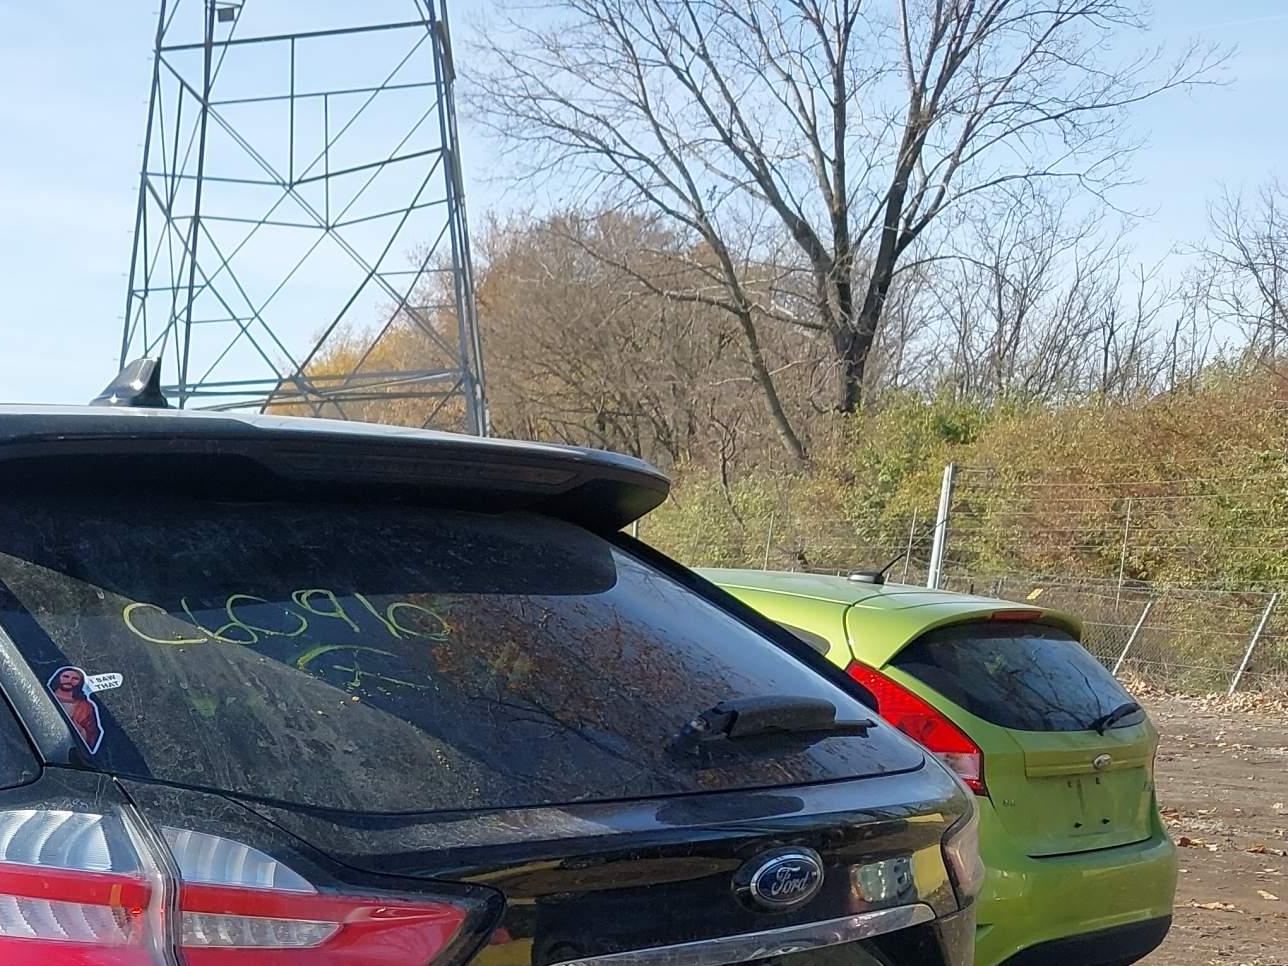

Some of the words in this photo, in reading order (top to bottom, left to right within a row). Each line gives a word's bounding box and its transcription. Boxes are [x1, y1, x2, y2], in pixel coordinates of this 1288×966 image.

[95, 674, 116, 683] SAW
[95, 681, 119, 690] THAT
[771, 866, 810, 896] Ford
